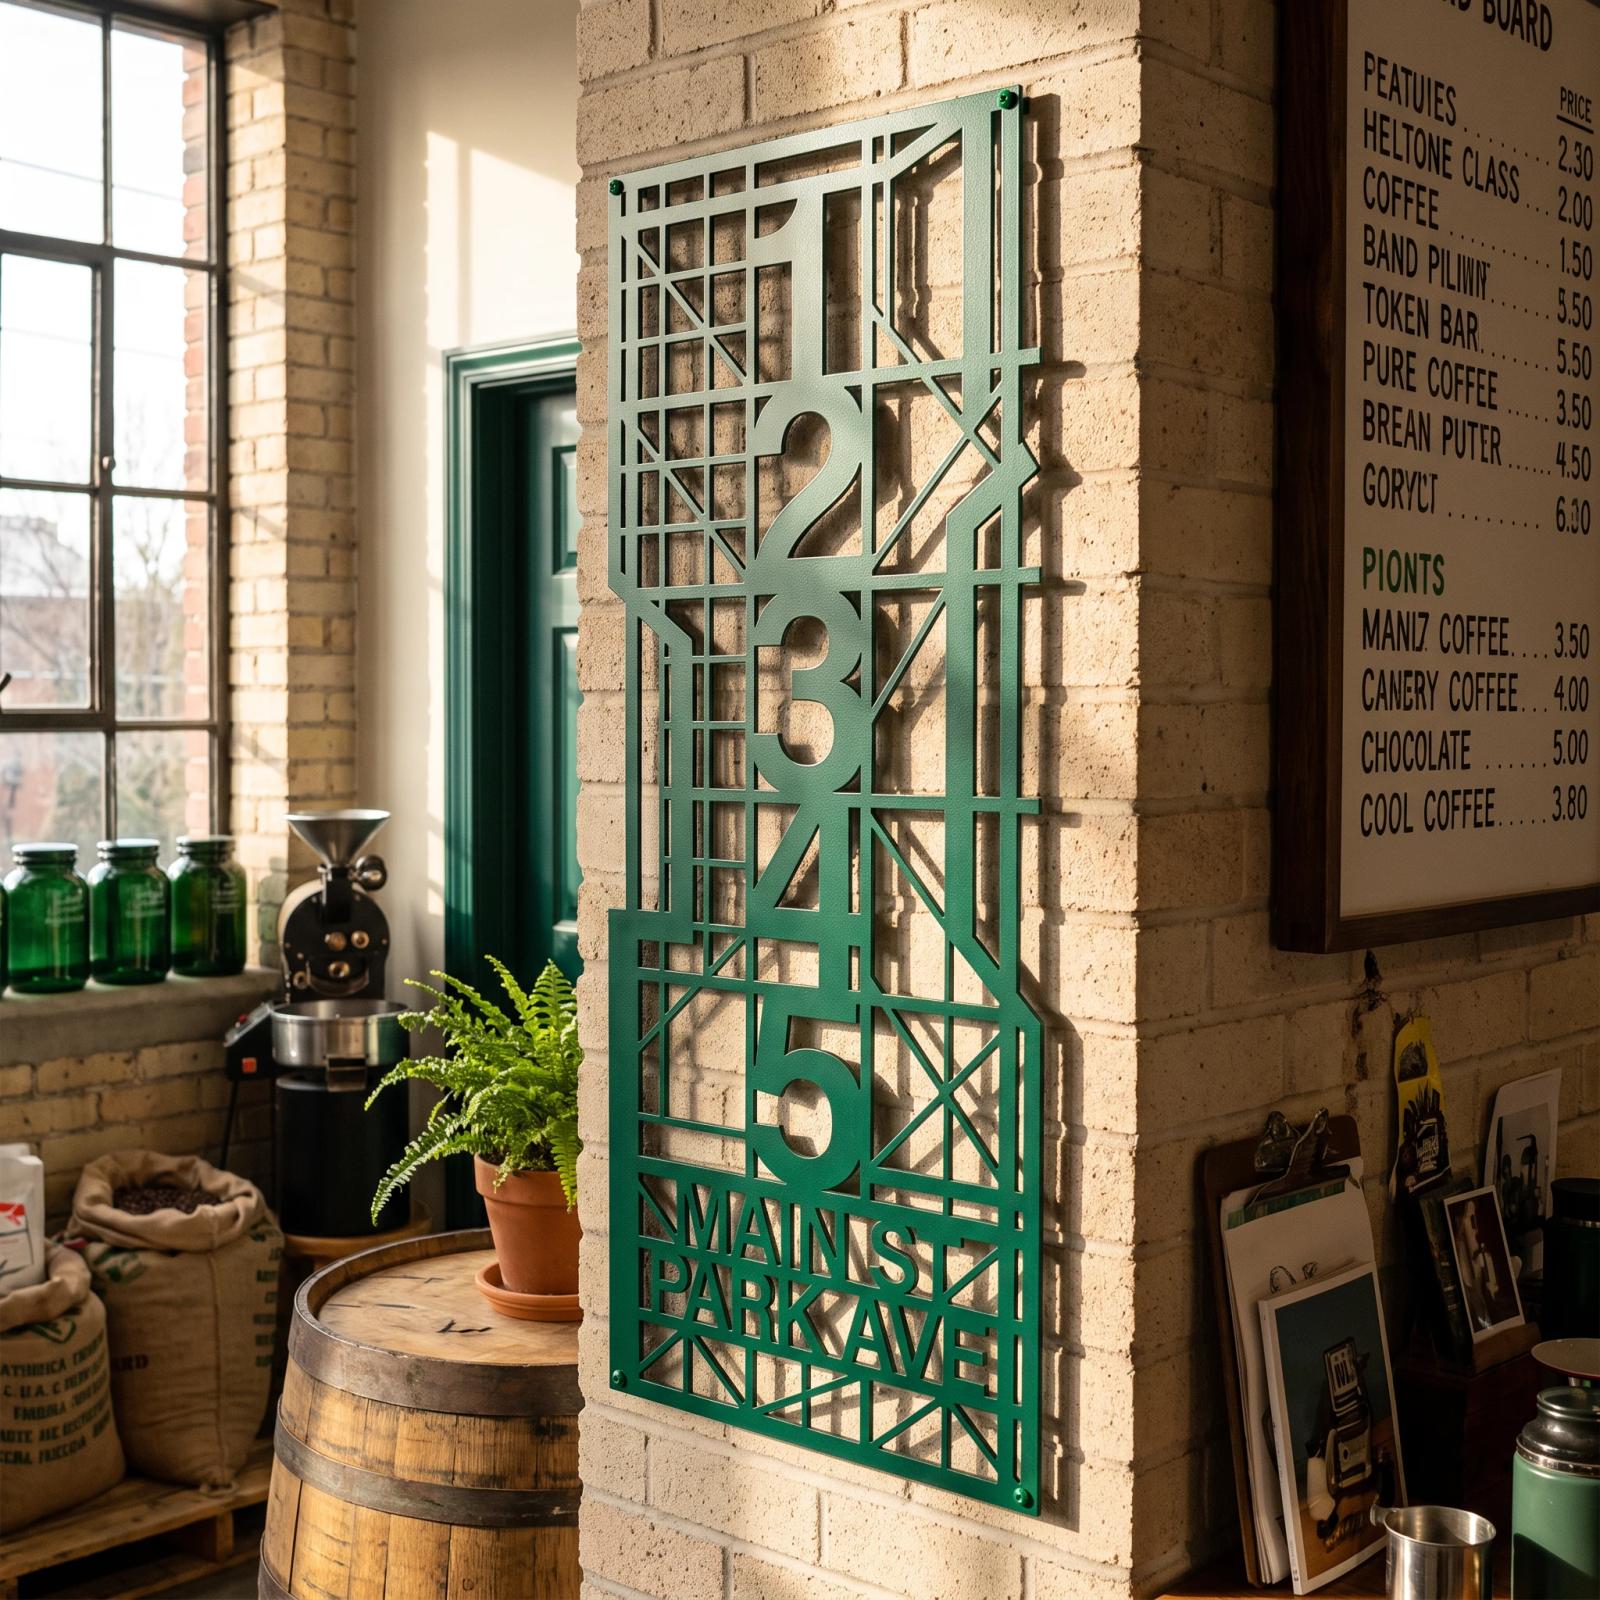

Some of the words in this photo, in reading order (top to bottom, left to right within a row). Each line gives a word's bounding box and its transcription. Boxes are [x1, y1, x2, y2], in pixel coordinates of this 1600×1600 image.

[1364, 51, 1456, 126] PEATUIES
[1558, 135, 1593, 181] 2.30
[1560, 86, 1592, 123] PRICE
[1364, 108, 1452, 180] HELTONE
[1463, 146, 1519, 203] CLASS
[1558, 186, 1593, 231] 2.00
[1363, 166, 1439, 230] COFFEE
[1559, 237, 1592, 280] 1.50
[1364, 224, 1417, 277] BAND
[1363, 282, 1428, 339] TOKEN
[1441, 304, 1479, 351] BAR
[1557, 338, 1592, 380] 5.50
[1363, 341, 1416, 392] PURE
[1428, 357, 1498, 410] COFFEE
[1557, 389, 1591, 430] 3.50
[1363, 399, 1431, 452] BREAN
[1556, 442, 1591, 481] 4.50
[1363, 547, 1444, 596] PIONTS
[1440, 613, 1509, 656] COFFEE
[1555, 622, 1589, 659] 3.50
[1449, 671, 1518, 712] COFFEE
[1554, 675, 1589, 712] 4.00
[1361, 730, 1471, 774] CHOCOLATE
[1553, 729, 1588, 765] 5.00
[1360, 792, 1413, 837] COOL
[1424, 788, 1495, 832] COFFEE
[1552, 785, 1587, 821] 3.80
[677, 1178, 850, 1281] MAIN
[869, 1217, 966, 1302] ST
[651, 1250, 831, 1361] PARK
[839, 1293, 991, 1399] AVE
